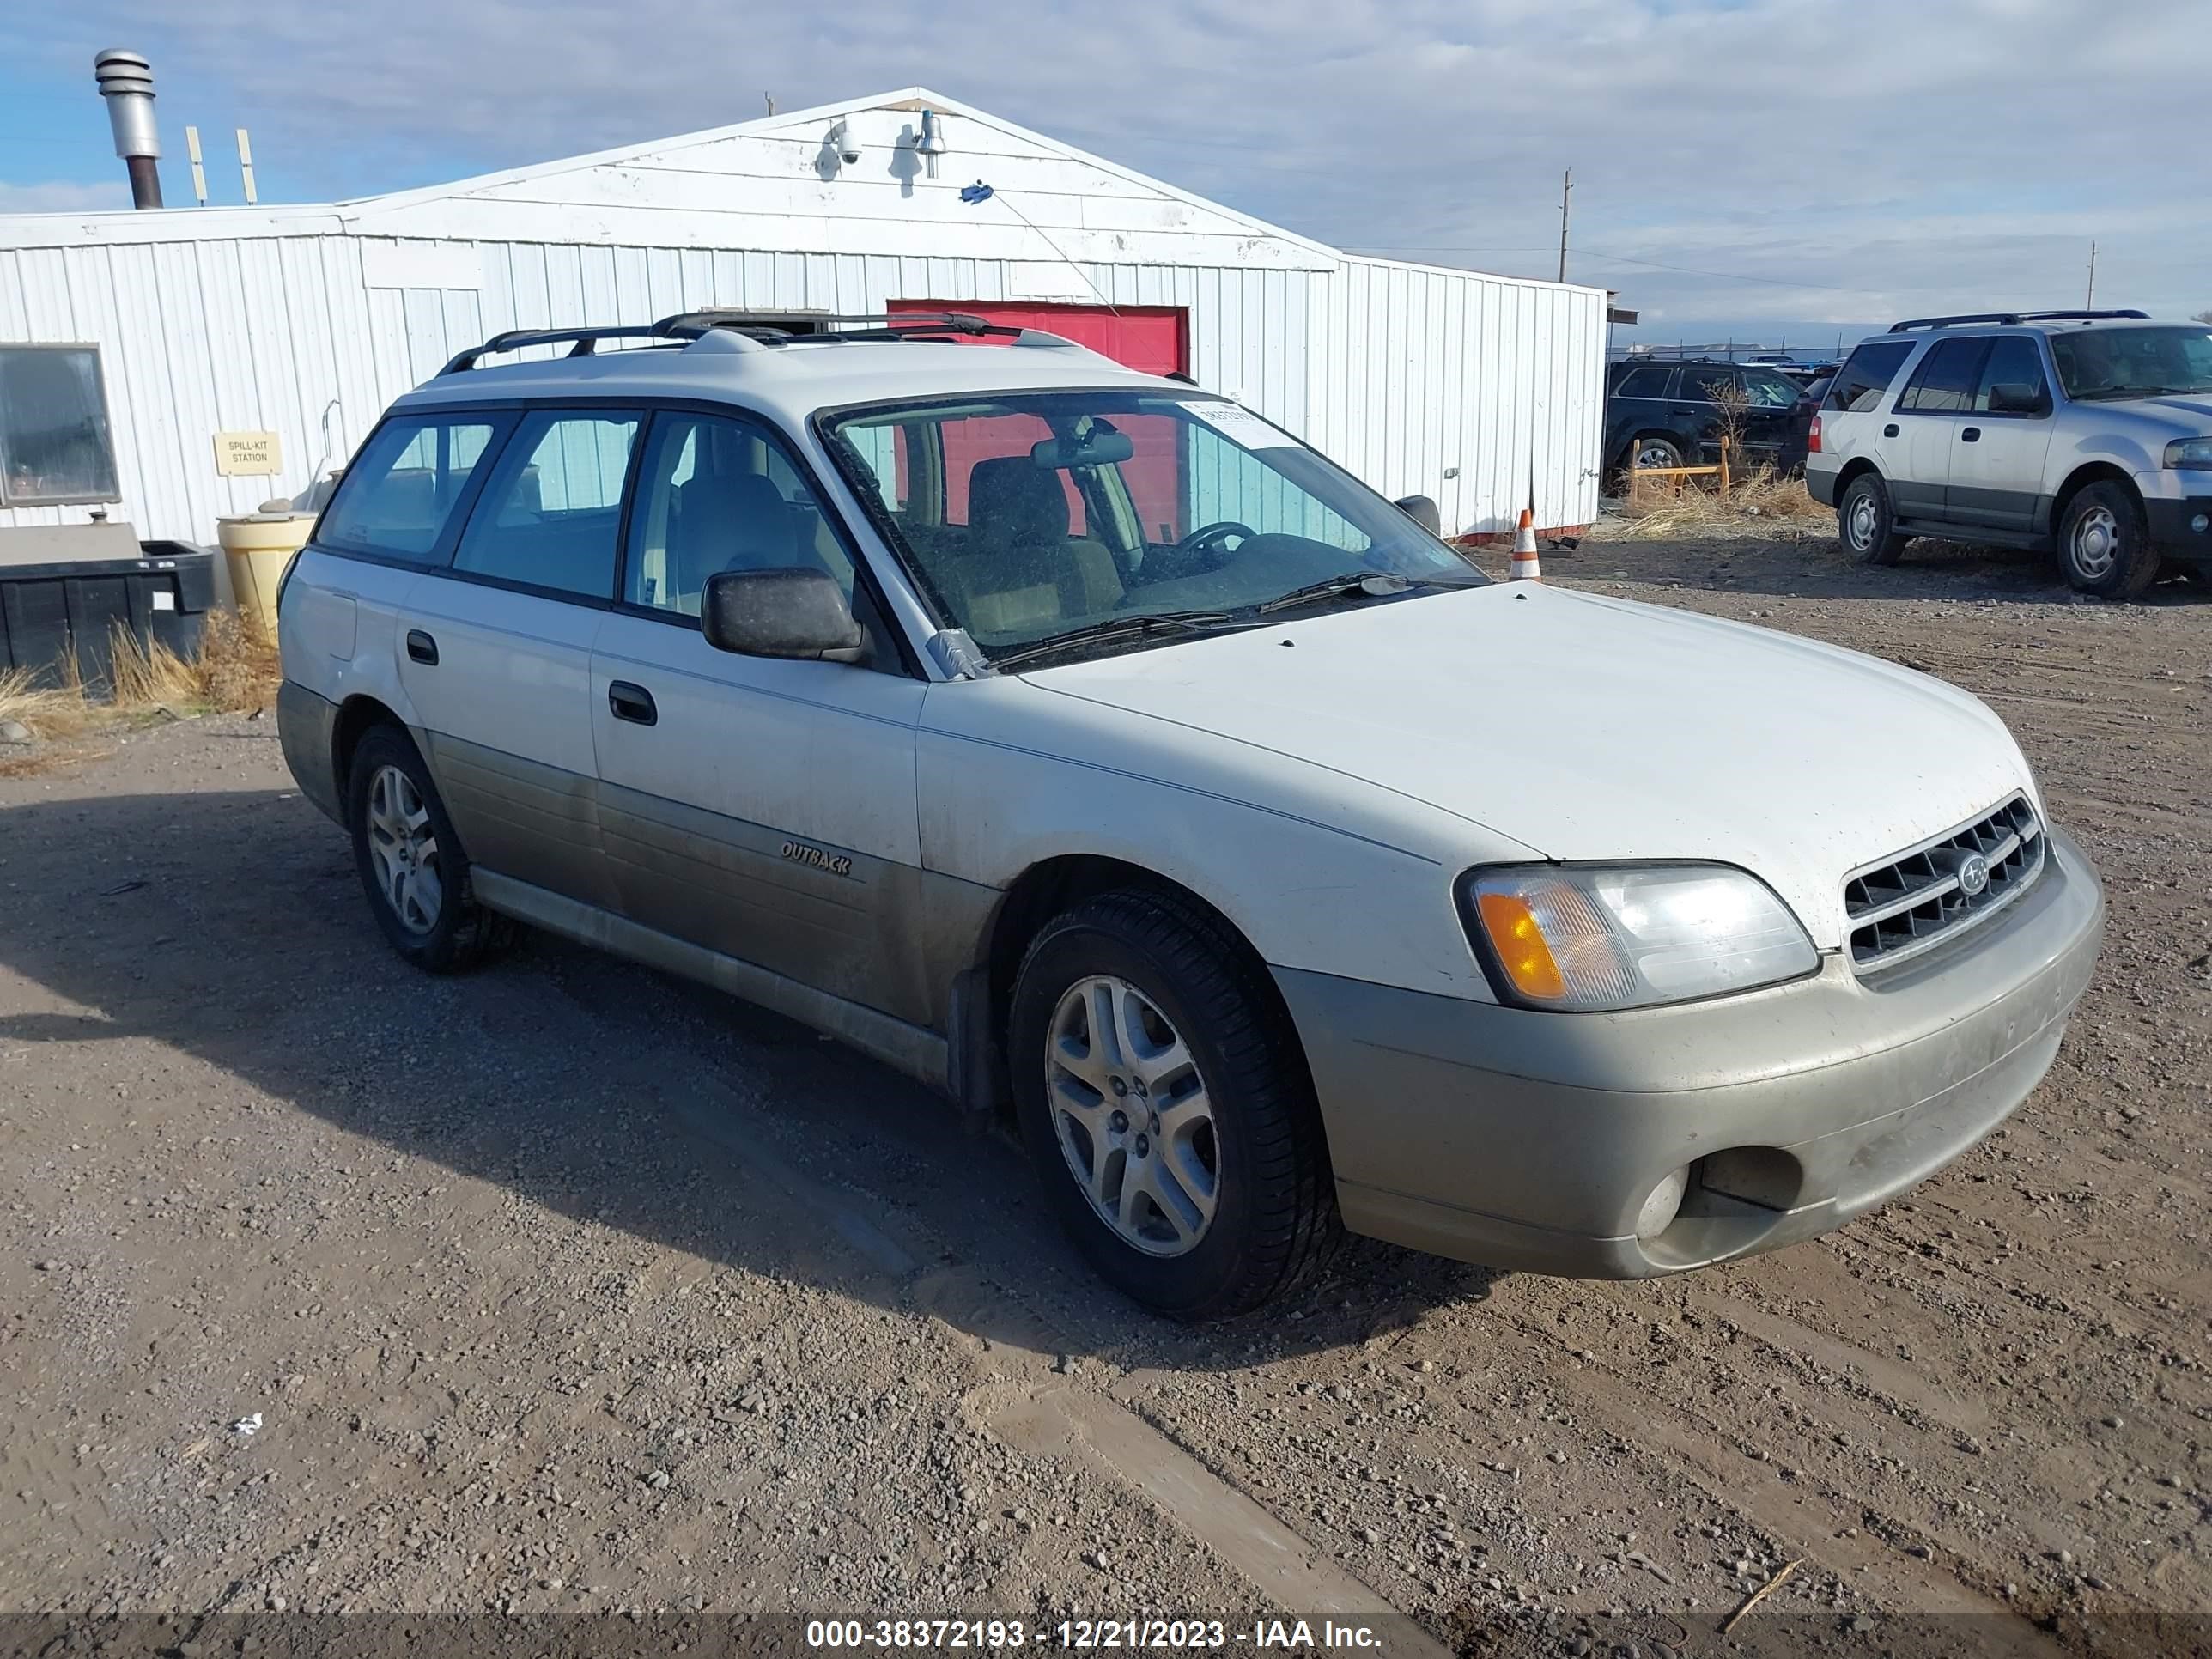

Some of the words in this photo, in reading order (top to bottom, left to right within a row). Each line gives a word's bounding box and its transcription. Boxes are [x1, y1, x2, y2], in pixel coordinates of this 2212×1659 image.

[228, 441, 268, 451] SPILL-KIT
[233, 453, 268, 462] STATION
[781, 841, 852, 876] OUTBACK
